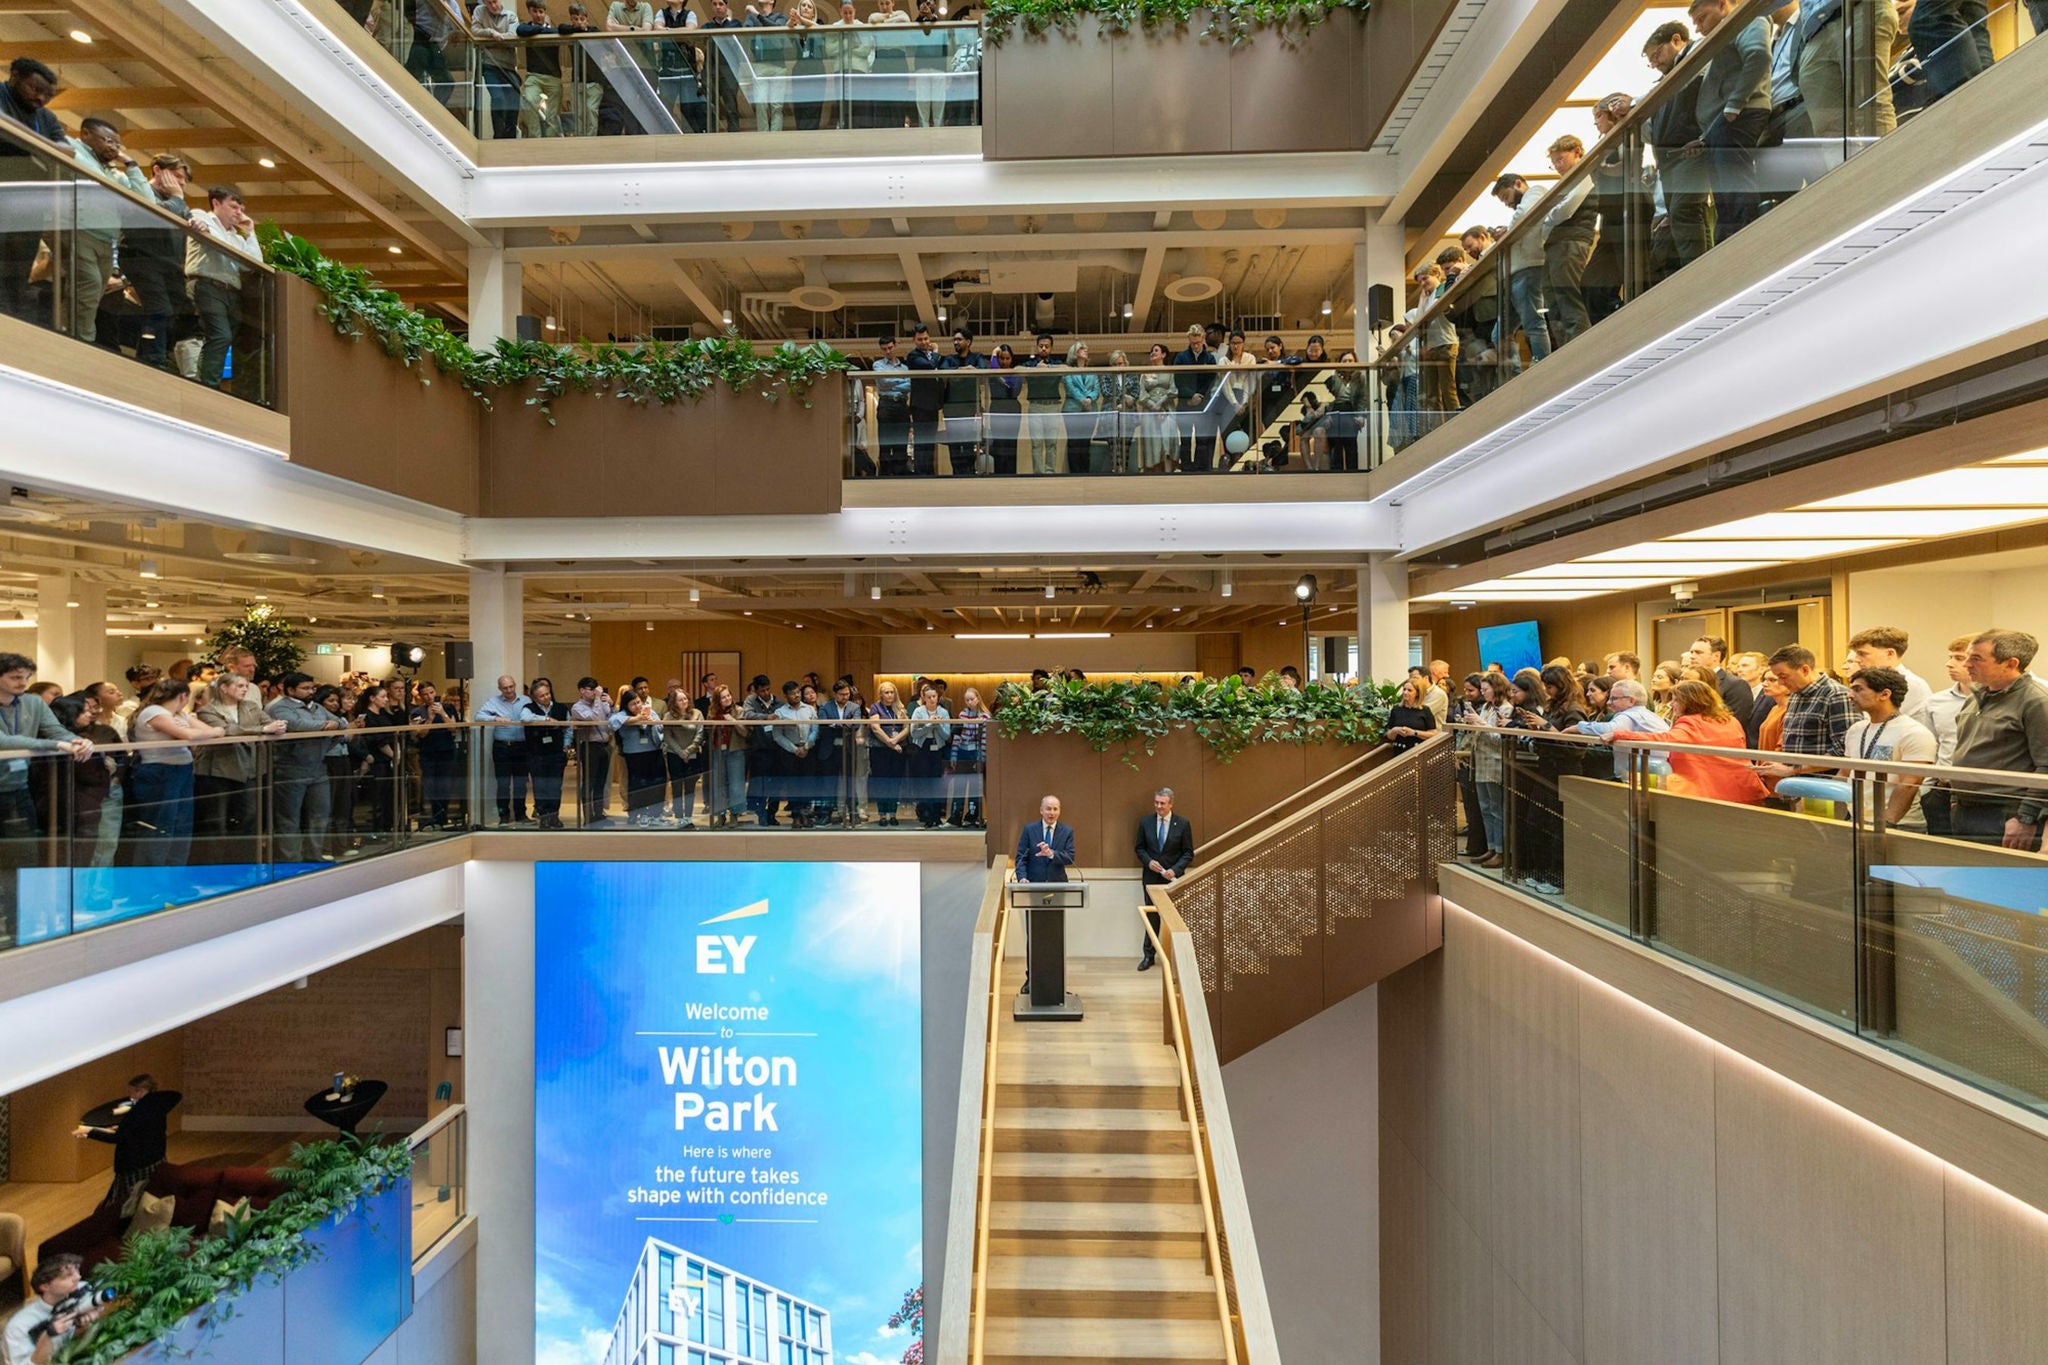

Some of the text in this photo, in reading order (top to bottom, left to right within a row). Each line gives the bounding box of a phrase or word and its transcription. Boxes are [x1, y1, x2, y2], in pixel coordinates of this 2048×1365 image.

[696, 935, 757, 974] EY
[685, 1002, 769, 1021] Welcome
[720, 1026, 734, 1039] to
[658, 1045, 798, 1087] Wilton
[674, 1092, 778, 1132] Park
[683, 1146, 771, 1159] Here is where
[655, 1166, 799, 1185] the future takes
[628, 1186, 828, 1206] shape with confidence
[668, 1288, 700, 1317] EY
